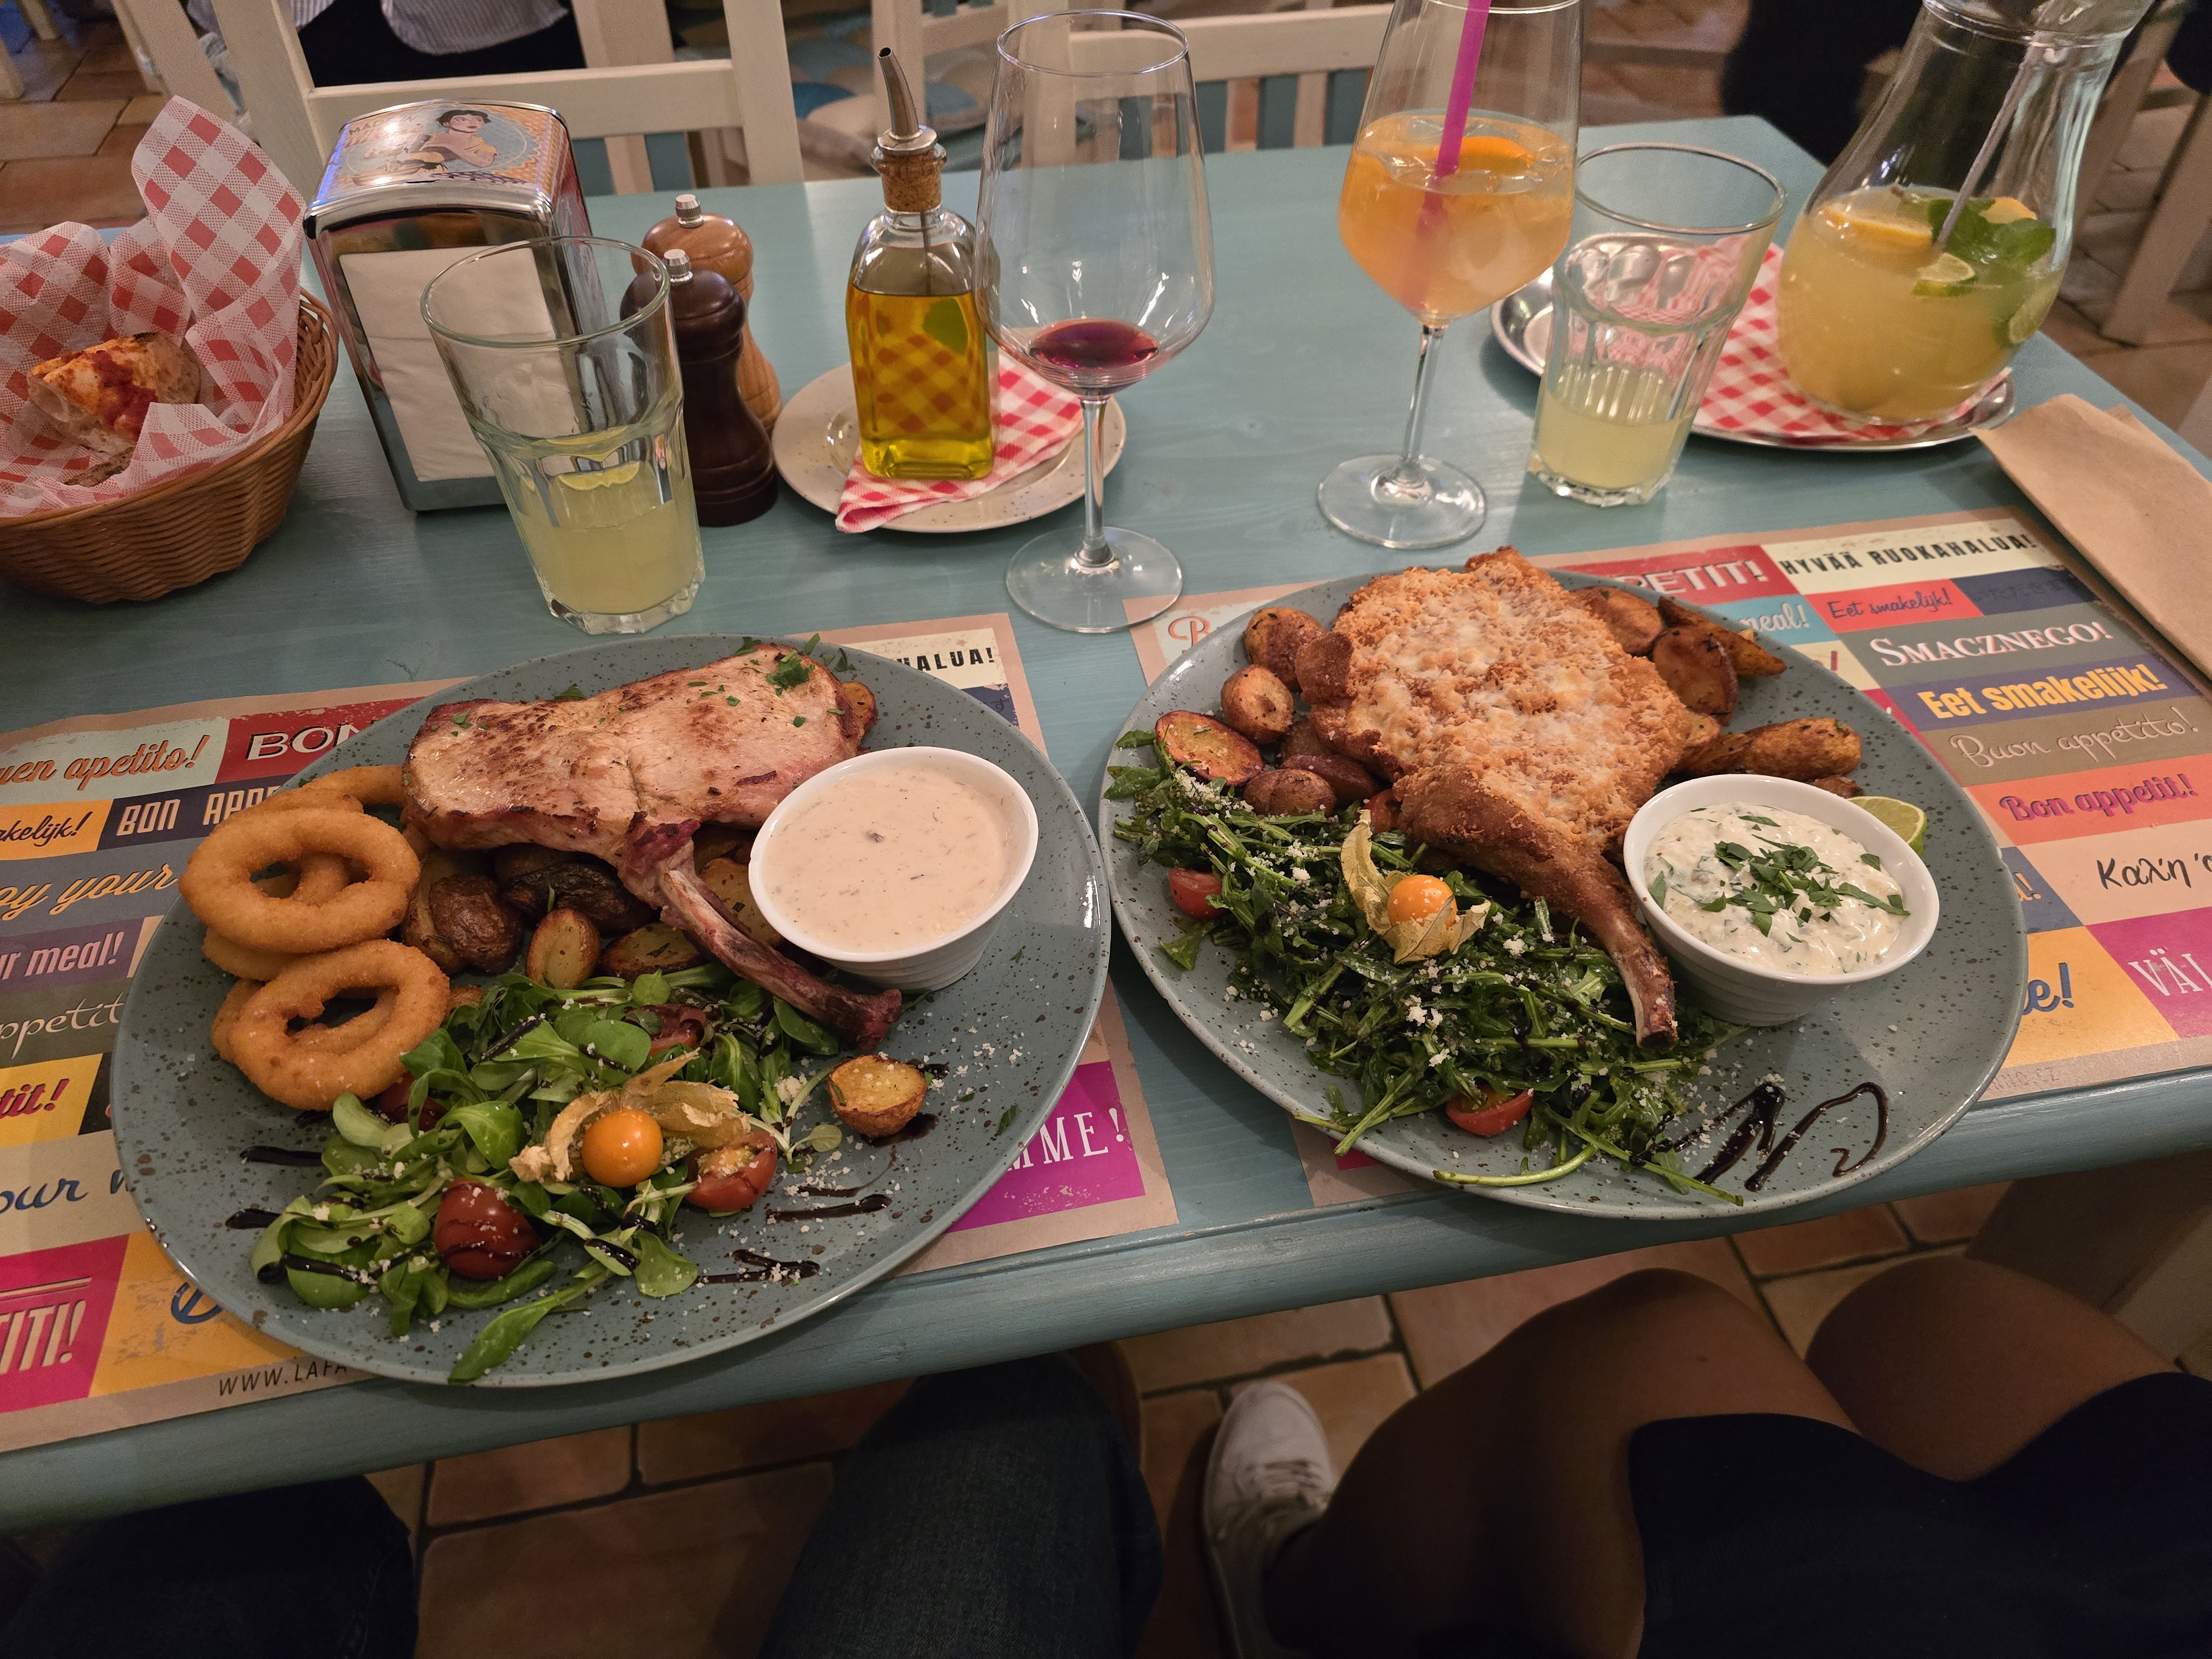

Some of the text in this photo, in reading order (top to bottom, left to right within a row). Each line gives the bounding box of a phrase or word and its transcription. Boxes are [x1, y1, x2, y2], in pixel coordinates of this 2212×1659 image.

[349, 116, 395, 135] MAD
[1779, 534, 2037, 575] HYVÄÄ RUOKAHALUA!
[1828, 601, 1864, 619] Eet
[1870, 587, 1952, 614] smakelijk!
[1917, 664, 2168, 719] Eet smakelijk!
[1949, 705, 2199, 768] Buon appetito!
[63, 734, 211, 791] apetito!
[116, 799, 181, 836] BON
[1999, 773, 2199, 821] Bon appetit!
[48, 863, 179, 915] your
[24, 931, 124, 977] meal!
